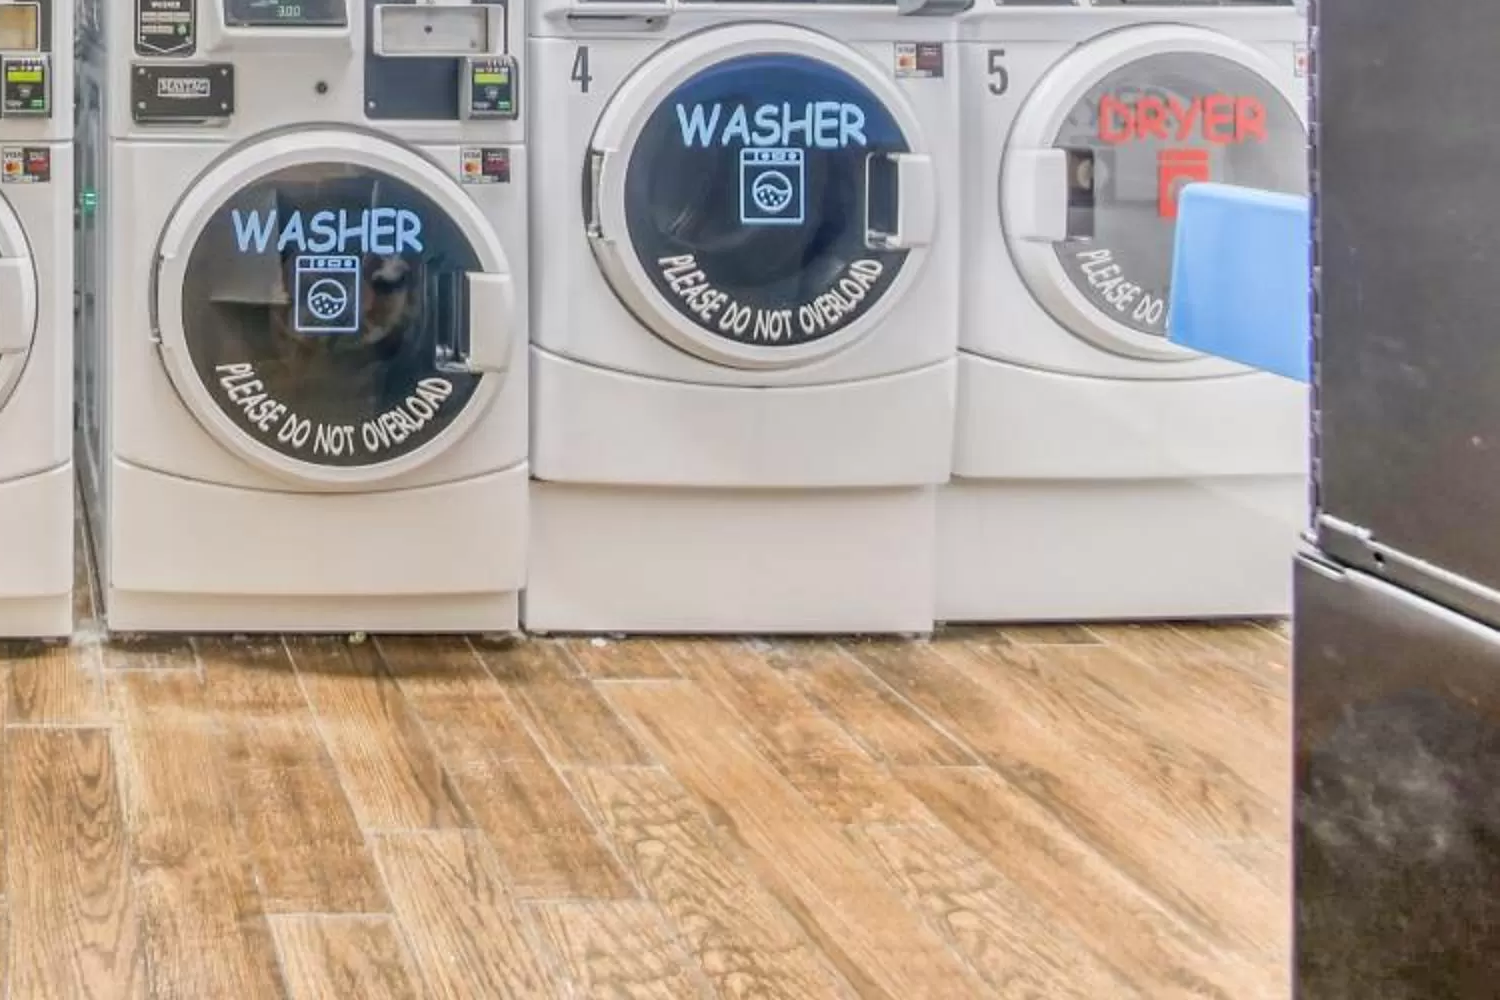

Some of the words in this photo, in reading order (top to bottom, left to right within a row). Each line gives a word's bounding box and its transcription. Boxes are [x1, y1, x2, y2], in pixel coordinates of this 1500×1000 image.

[570, 45, 593, 93] 4
[988, 49, 1009, 96] 5
[675, 101, 868, 148] WASHER
[1097, 93, 1269, 145] DRYER
[231, 206, 424, 255] WASHER
[657, 253, 727, 320] PLEASE
[719, 302, 753, 336] DO
[753, 308, 794, 341] NOT
[799, 258, 884, 335] OVERLOAD
[1076, 248, 1141, 312] PLEASE
[1131, 294, 1164, 327] DO
[215, 361, 286, 432] PLEASE
[277, 412, 311, 449] DO
[313, 422, 356, 456] NOT
[362, 376, 454, 453] OVERLOAD
